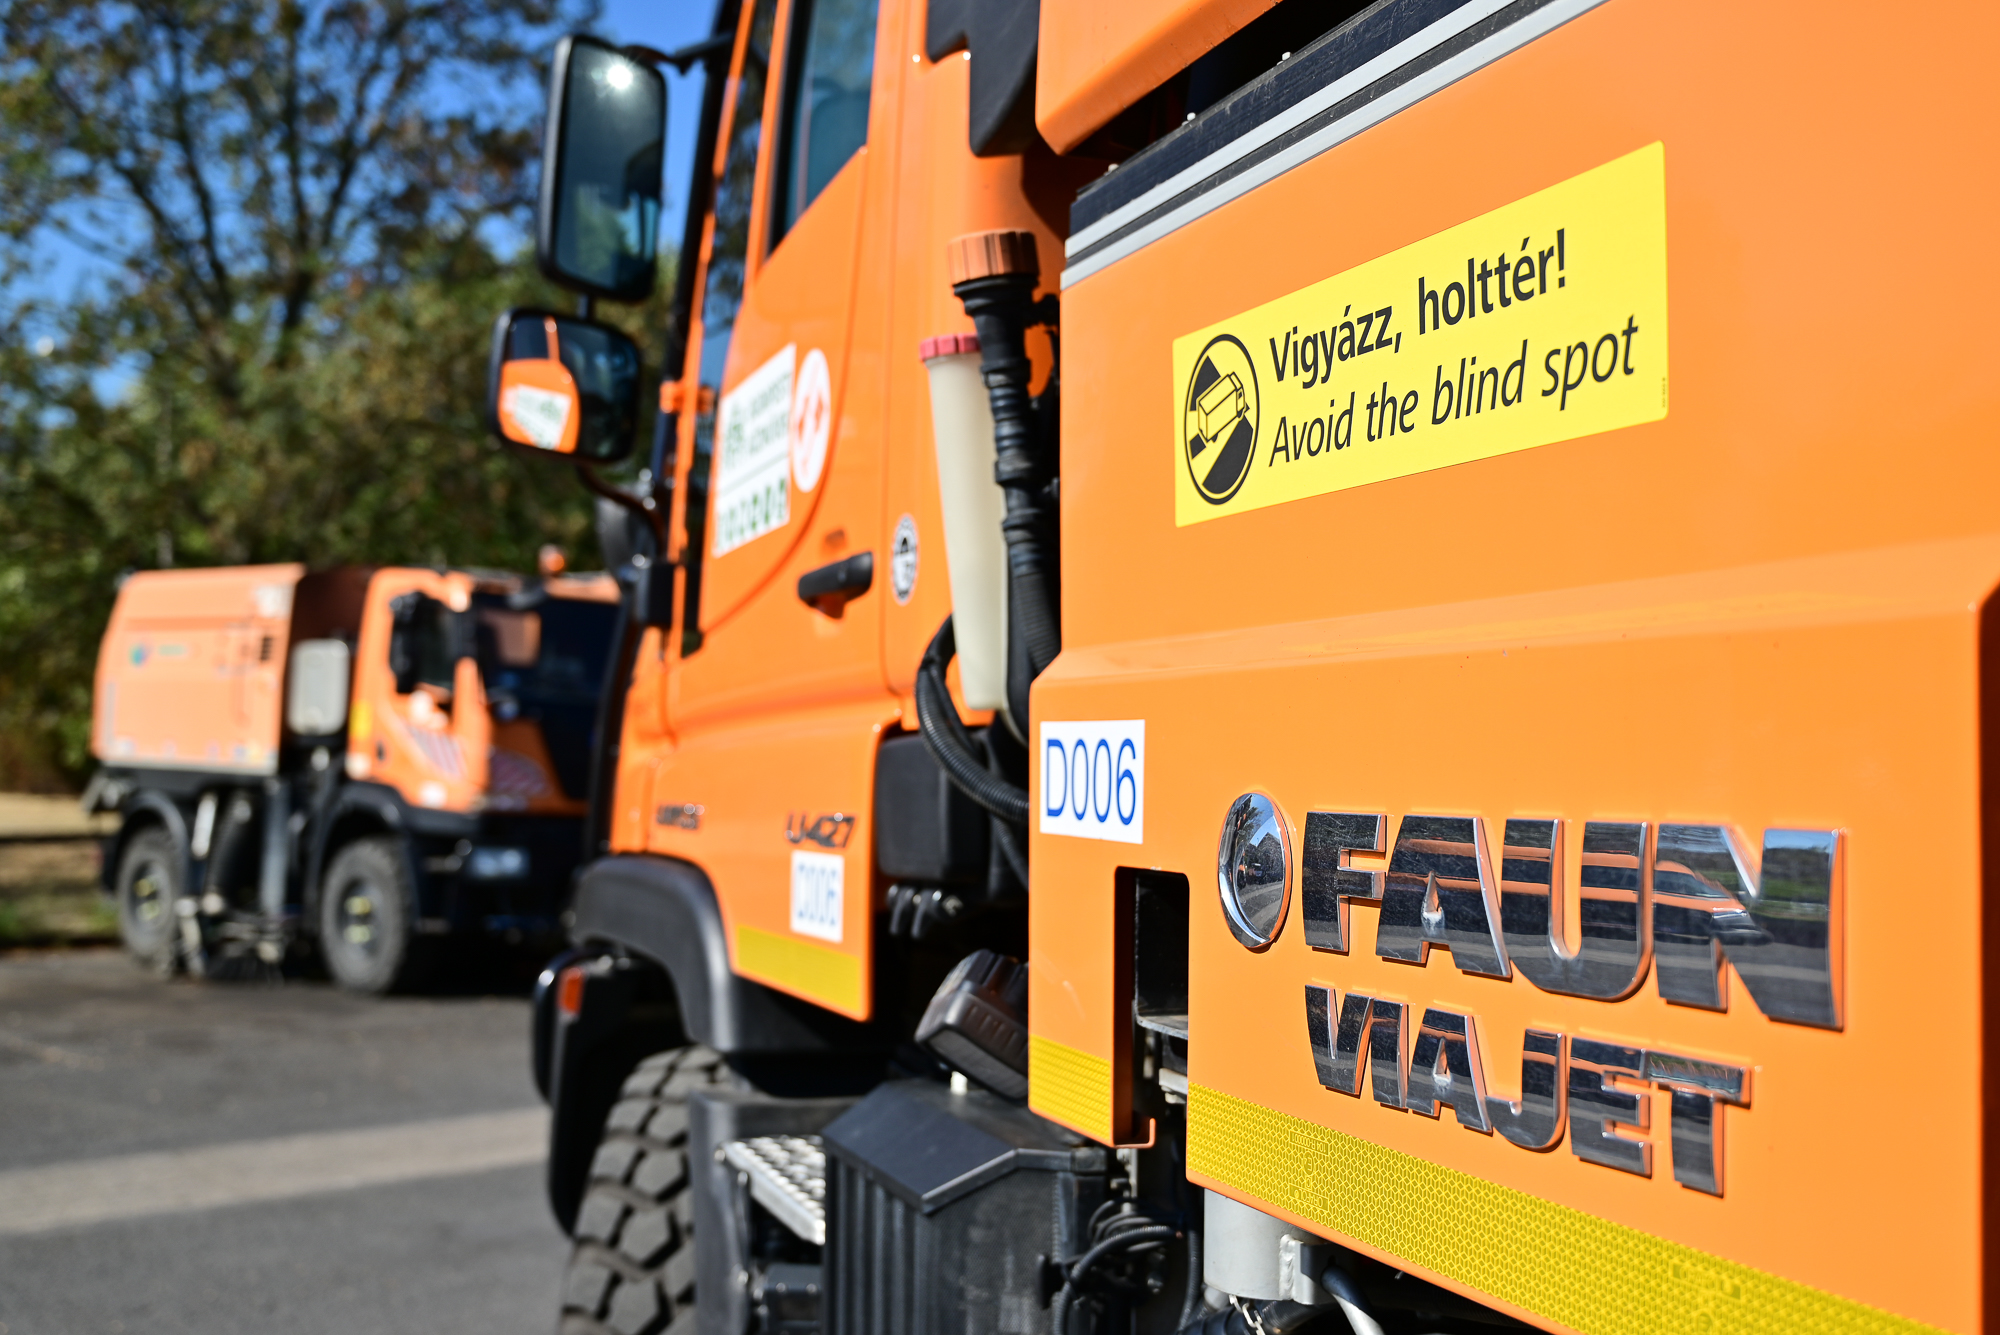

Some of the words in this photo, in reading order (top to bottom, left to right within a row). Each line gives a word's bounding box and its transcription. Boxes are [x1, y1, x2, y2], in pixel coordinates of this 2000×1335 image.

[1269, 304, 1402, 388] Vigyázz,
[1418, 228, 1566, 335] holttér!
[1269, 391, 1355, 467] Avoid
[1366, 382, 1418, 442] the
[1432, 339, 1528, 424] blind
[1541, 314, 1638, 411] spot
[1046, 738, 1136, 825] D006
[1302, 811, 1845, 1031] FAUN
[1305, 984, 1753, 1196] VIAJET
